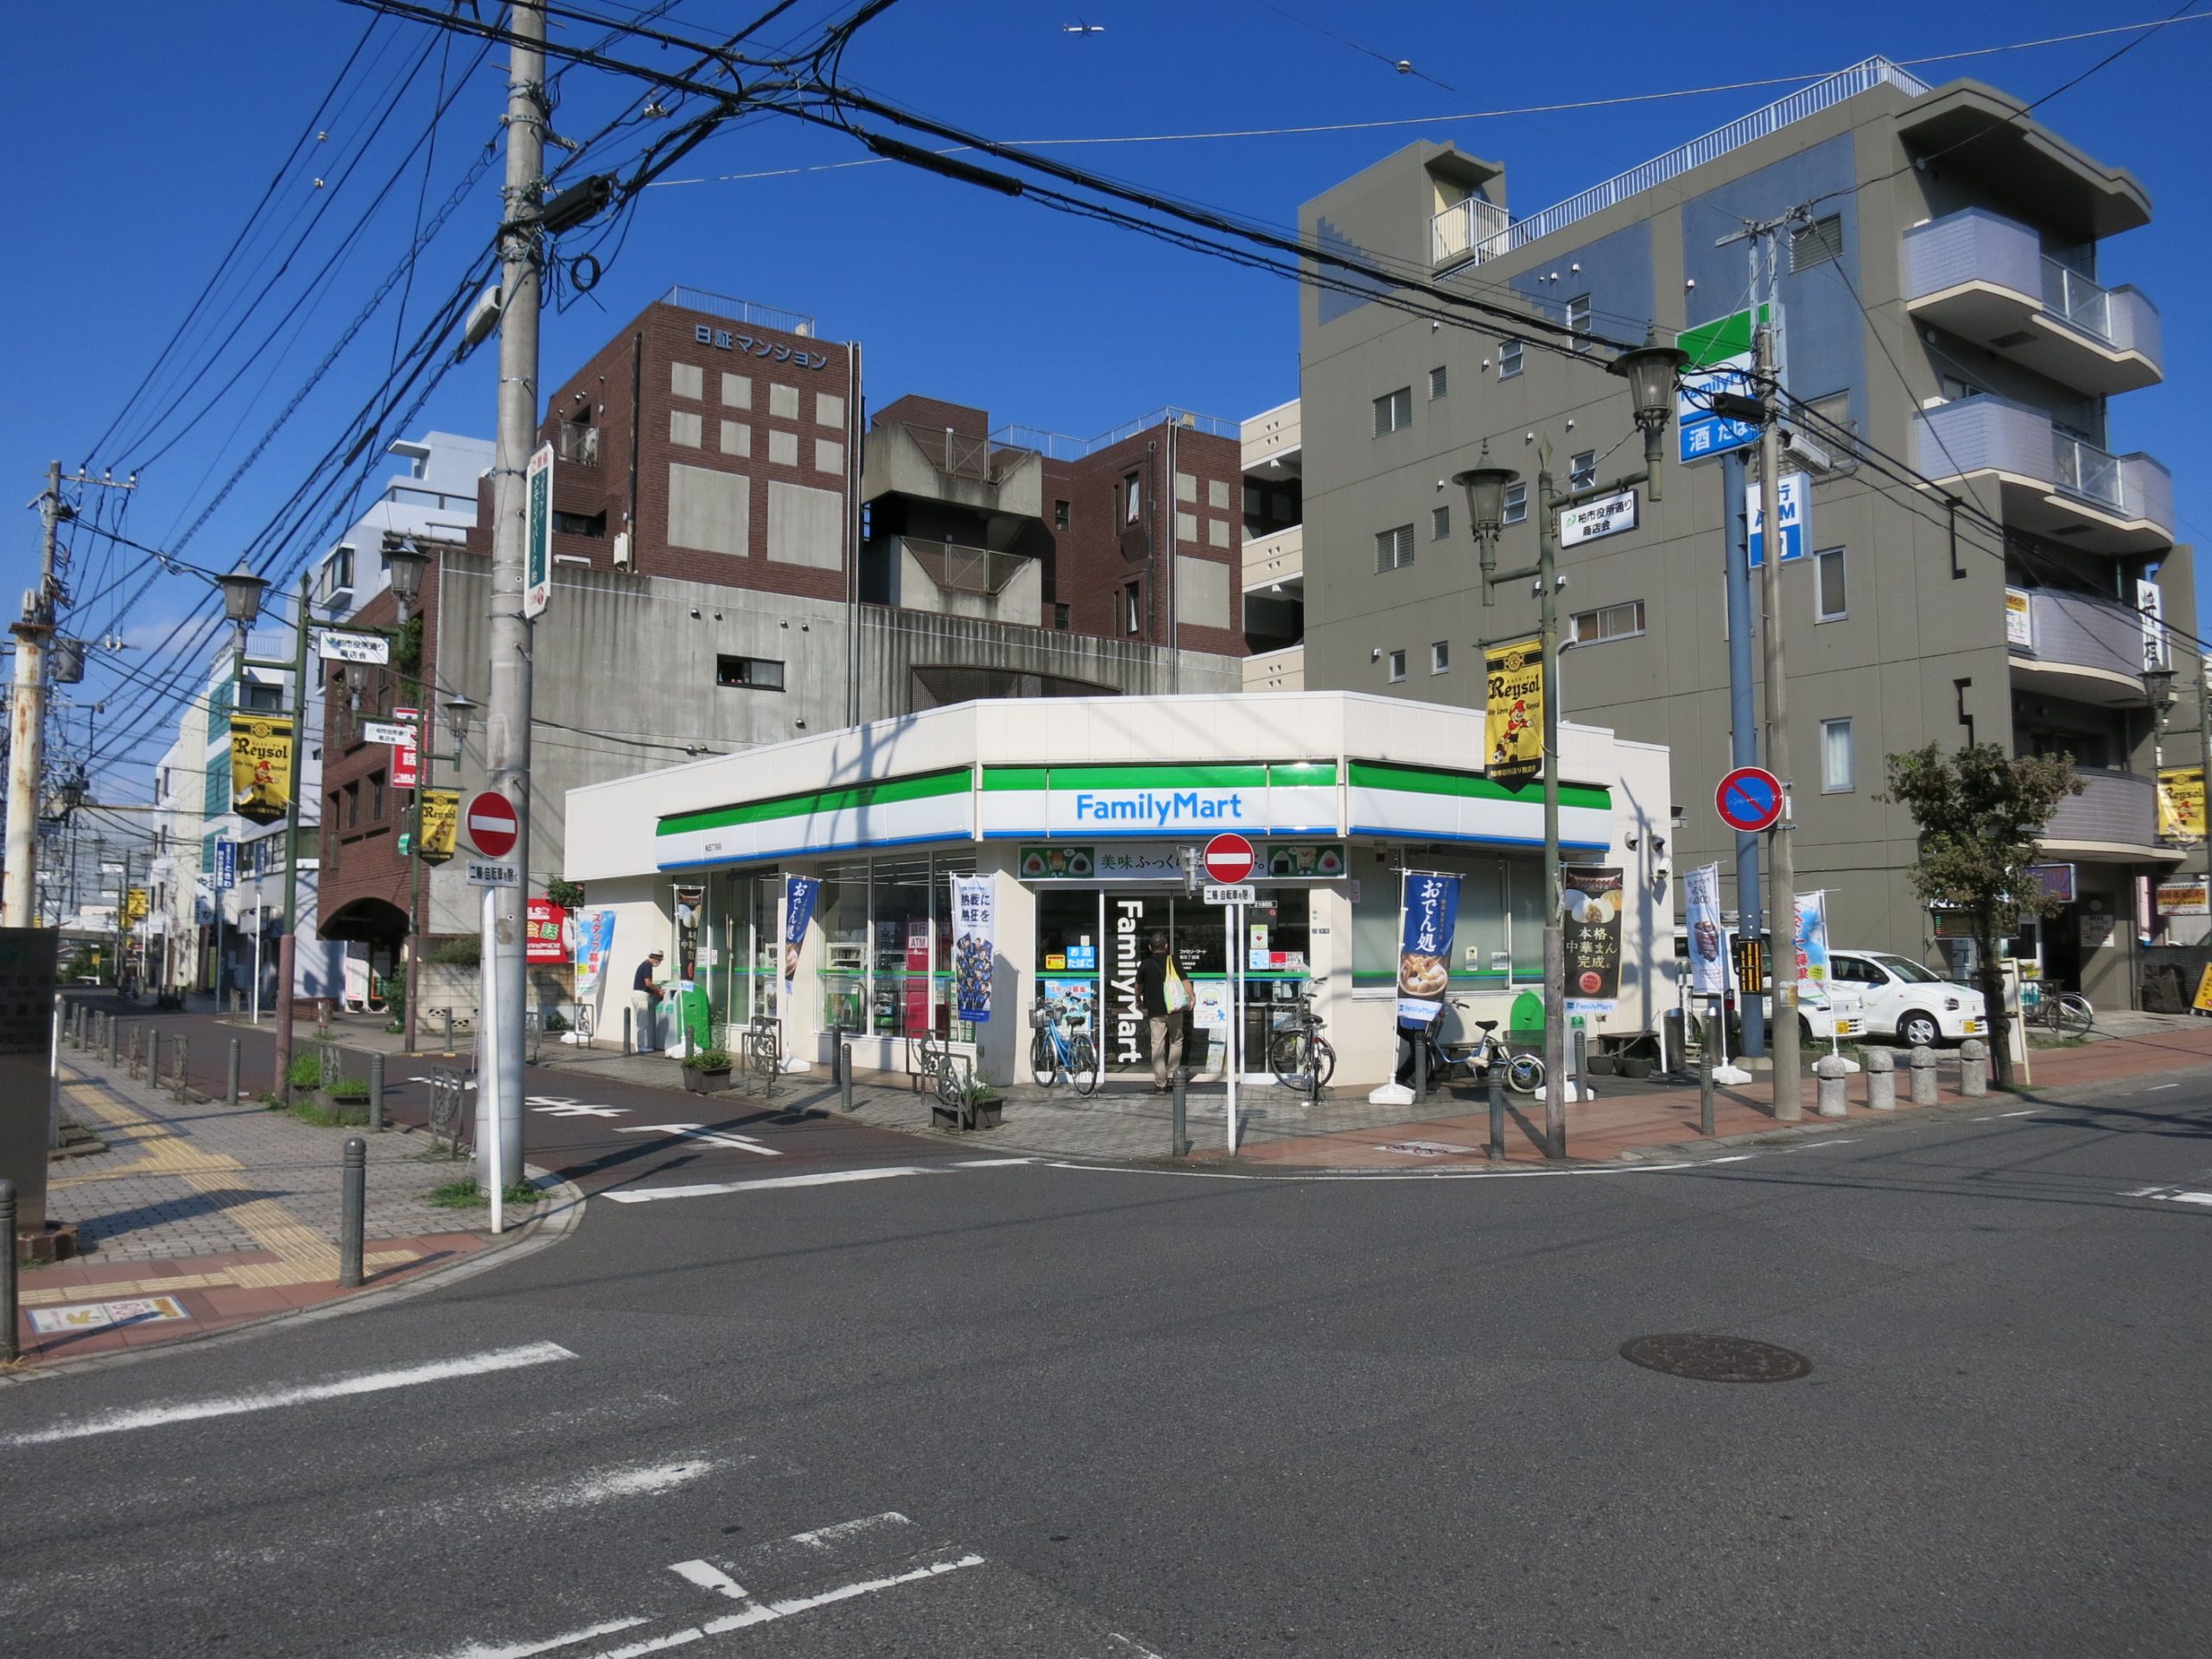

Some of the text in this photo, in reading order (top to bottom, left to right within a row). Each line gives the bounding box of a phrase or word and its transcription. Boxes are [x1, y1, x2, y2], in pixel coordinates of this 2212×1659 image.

[1689, 424, 1711, 453] 酒
[1578, 499, 1632, 524] 柏市役所通り
[1755, 502, 1796, 527] AM
[1583, 519, 1611, 537] 商店会
[338, 639, 385, 652] 柏市役所通り
[1488, 673, 1541, 701] Reysol
[1497, 706, 1509, 715] Love
[233, 737, 289, 760] Reysol
[1077, 792, 1242, 827] FamilyMart
[961, 893, 990, 906] 熱戦に
[961, 909, 990, 922] 熱狂を
[1415, 880, 1443, 952] おでん処
[910, 938, 926, 948] ATM
[1566, 940, 1618, 955] 中華まん
[1067, 958, 1094, 968] たばこ
[1110, 901, 1144, 1063] FamilyMart
